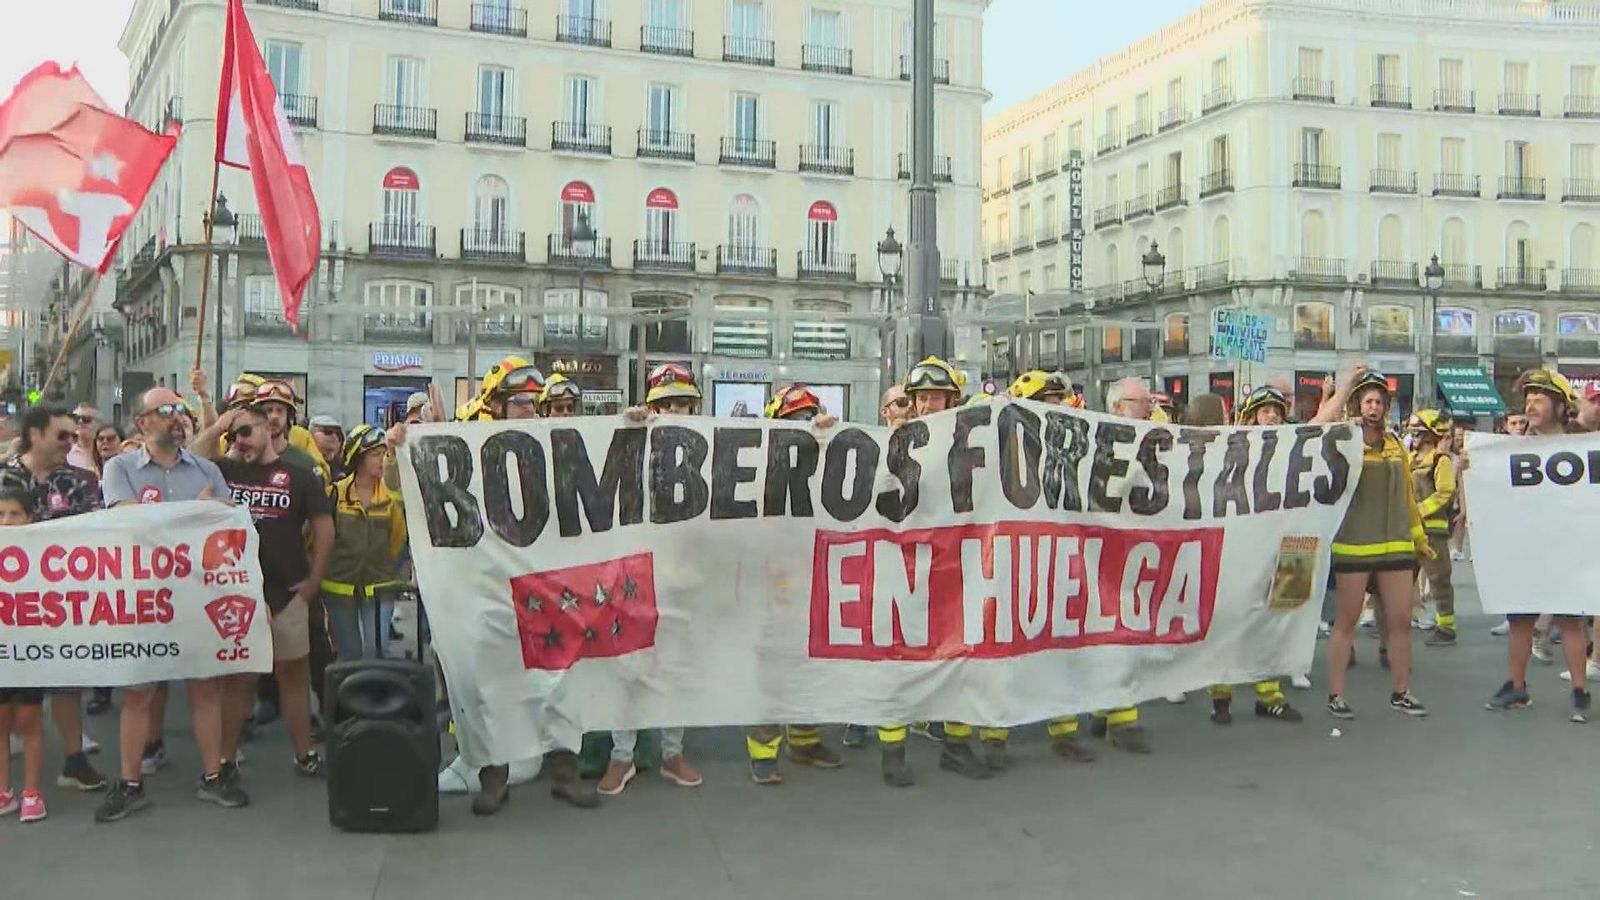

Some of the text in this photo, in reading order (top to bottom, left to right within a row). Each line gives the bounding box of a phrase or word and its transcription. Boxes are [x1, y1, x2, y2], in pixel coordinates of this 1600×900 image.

[1071, 158, 1082, 219] HOTEL
[374, 352, 422, 366] PRIMOR
[410, 402, 1351, 548] BOMBEROS FORESTALES
[1510, 450, 1600, 487] BO
[231, 489, 290, 508] ESPETO
[0, 543, 192, 583] O CON LOS
[204, 570, 249, 586] PCTE
[827, 534, 1203, 648] EN HUELGA
[13, 644, 55, 661] LOS
[59, 642, 180, 660] GOBIERNOS
[216, 647, 250, 661] CJC
